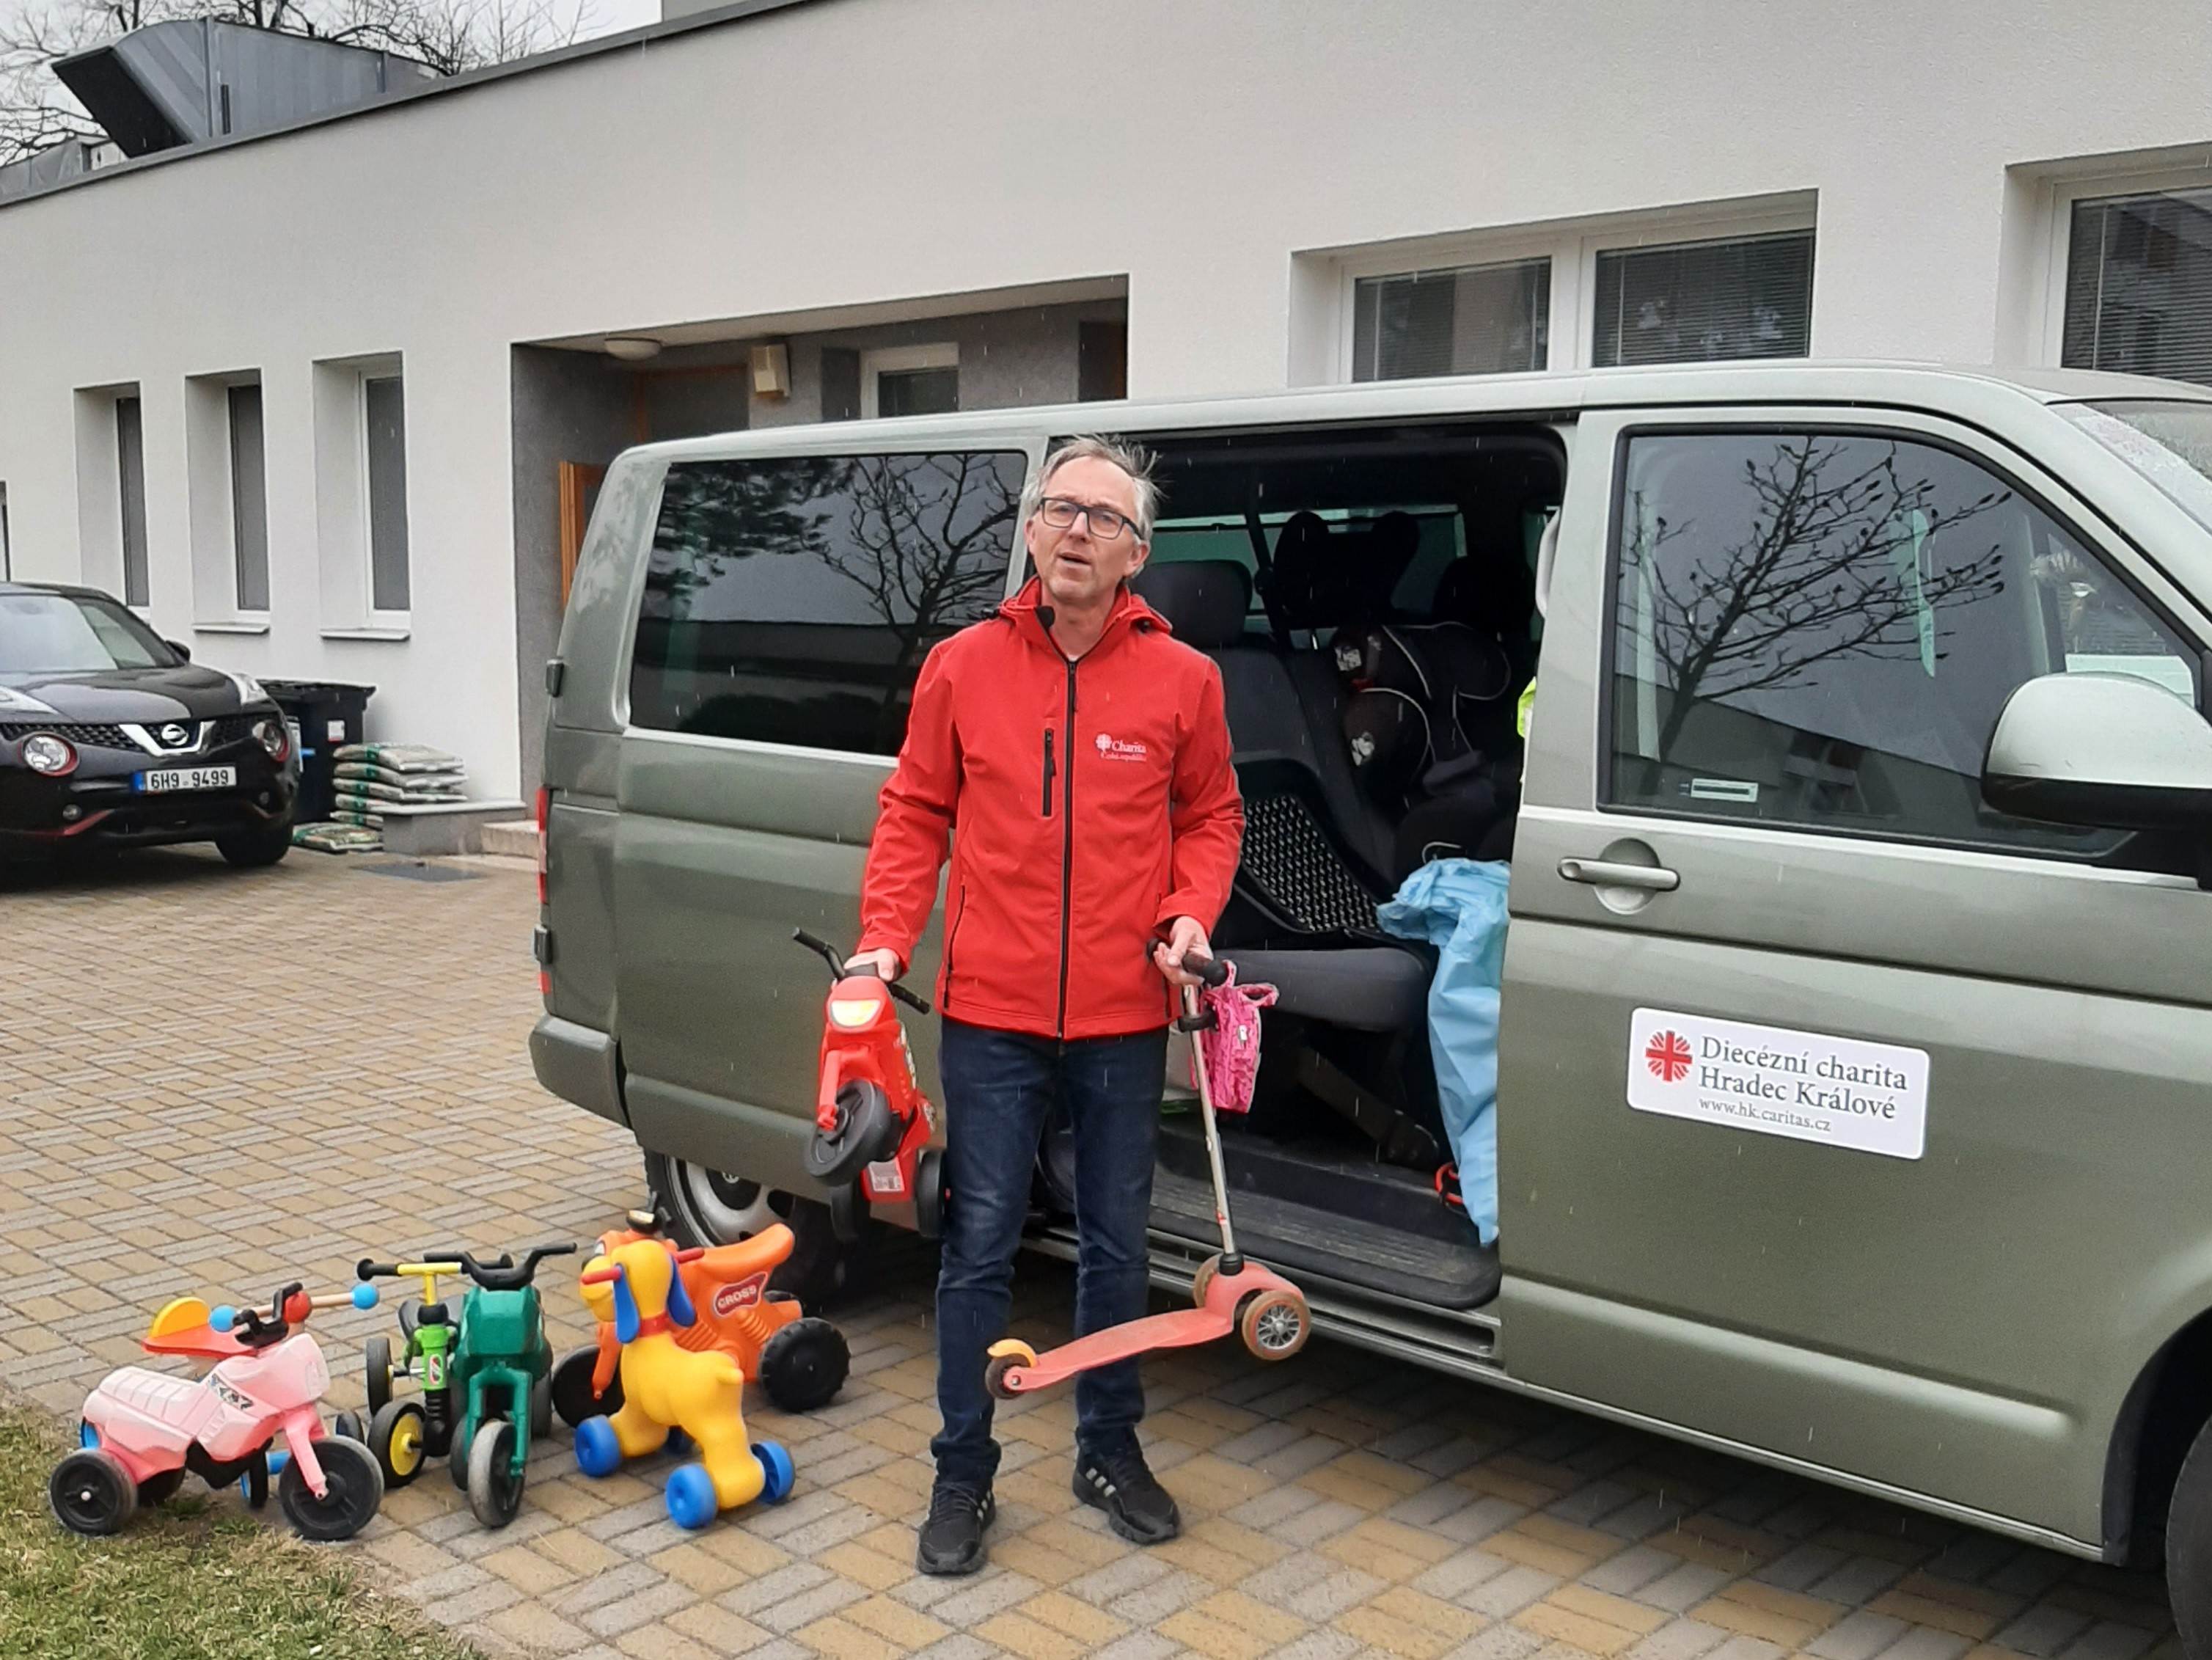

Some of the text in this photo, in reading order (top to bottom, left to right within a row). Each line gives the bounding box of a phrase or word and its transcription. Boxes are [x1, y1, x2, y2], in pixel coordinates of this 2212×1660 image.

[150, 769, 229, 789] 6H9 9499
[1701, 1036, 1907, 1090] Diecézní charita
[1699, 1066, 1896, 1119] Hradec Králové
[1699, 1098, 1831, 1132] www.hk.caritas.cz
